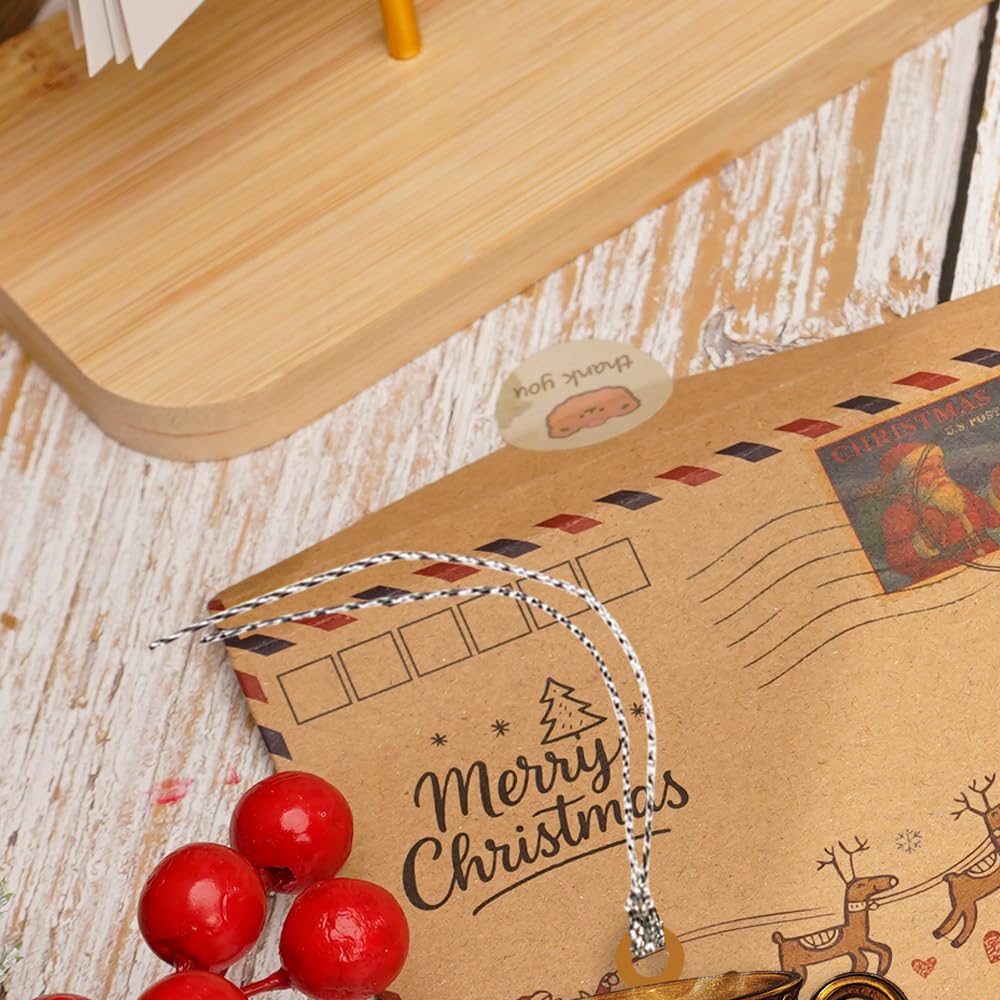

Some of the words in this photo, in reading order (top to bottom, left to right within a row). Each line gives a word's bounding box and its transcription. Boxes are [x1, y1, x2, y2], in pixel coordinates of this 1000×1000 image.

[513, 373, 555, 400] you
[562, 353, 633, 387] thank
[831, 390, 993, 464] CHRISTMAS
[414, 738, 624, 833] Merry
[402, 770, 690, 911] Christmas
